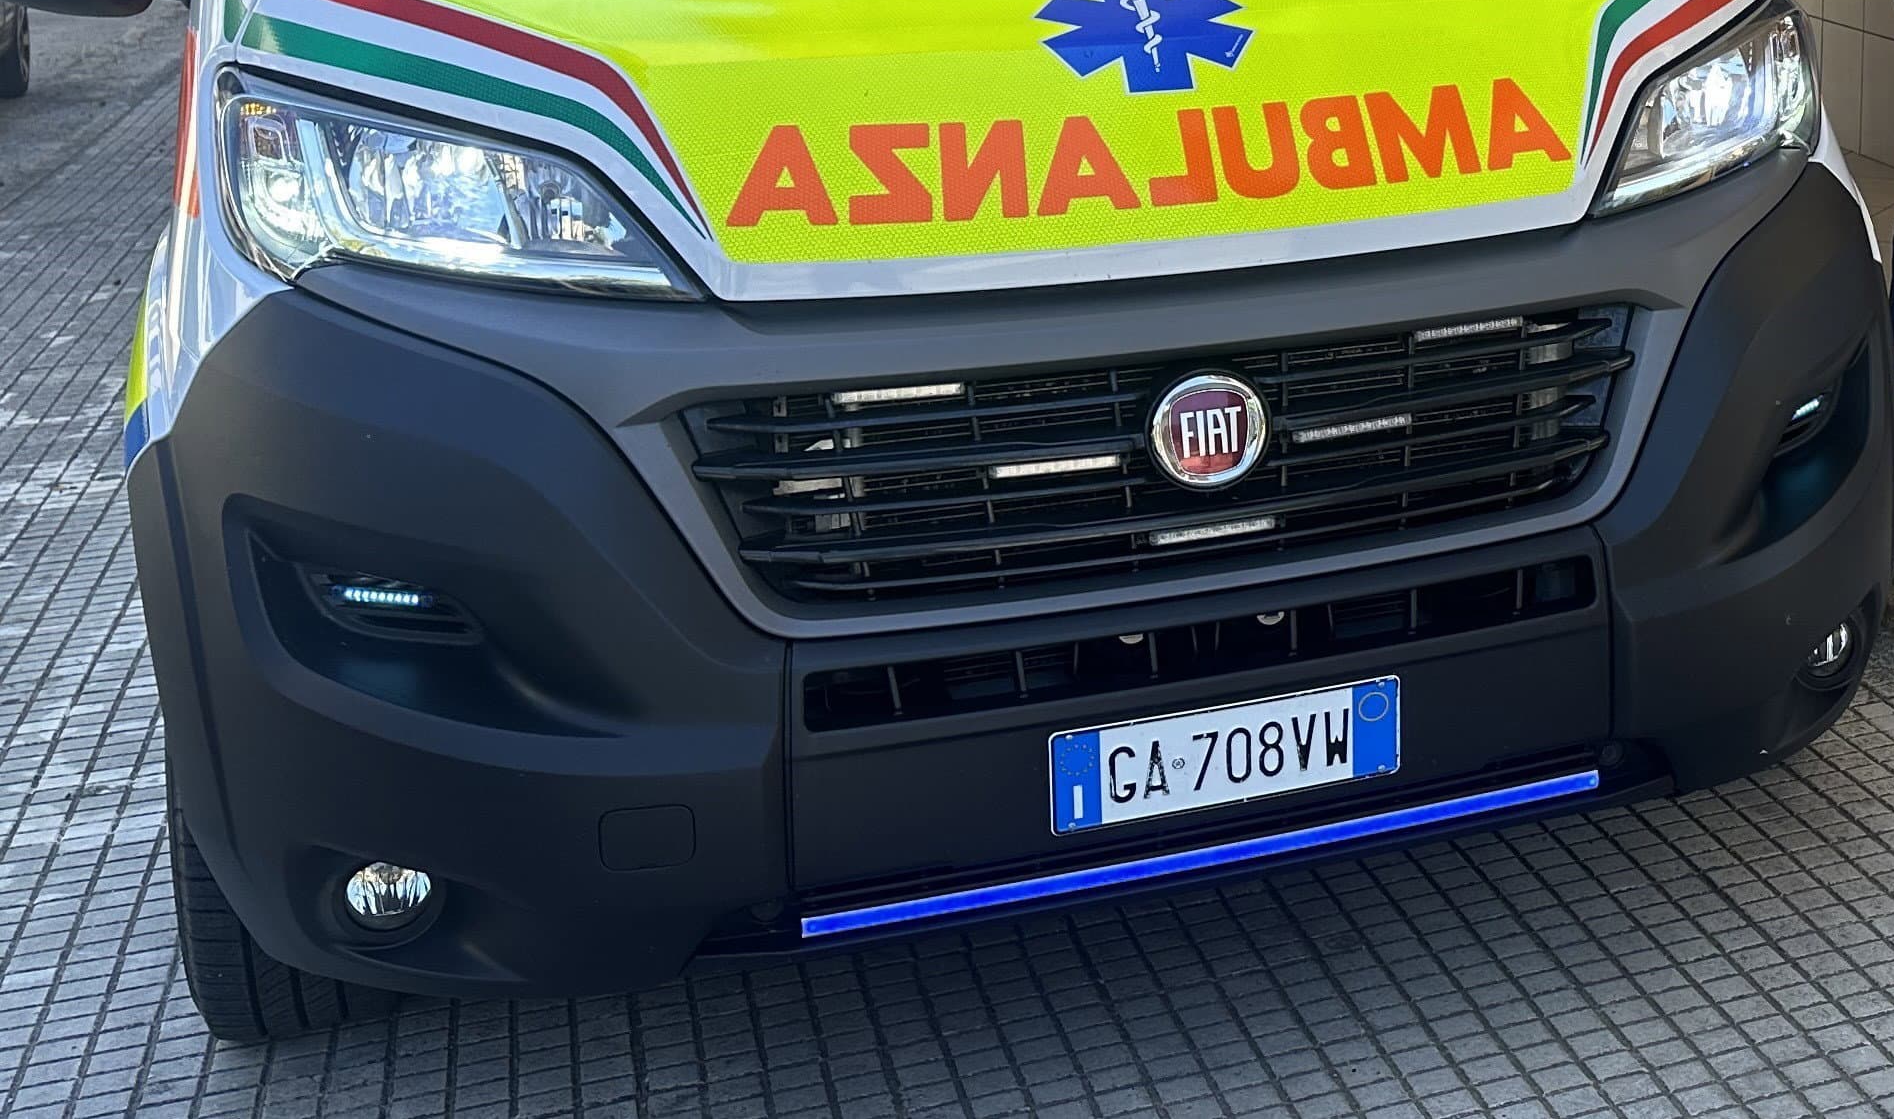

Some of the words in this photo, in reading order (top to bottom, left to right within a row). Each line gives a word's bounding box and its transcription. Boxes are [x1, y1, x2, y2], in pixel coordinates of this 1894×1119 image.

[1180, 405, 1241, 458] FIAT
[1108, 740, 1170, 804] GA
[1192, 708, 1350, 791] 708VW
